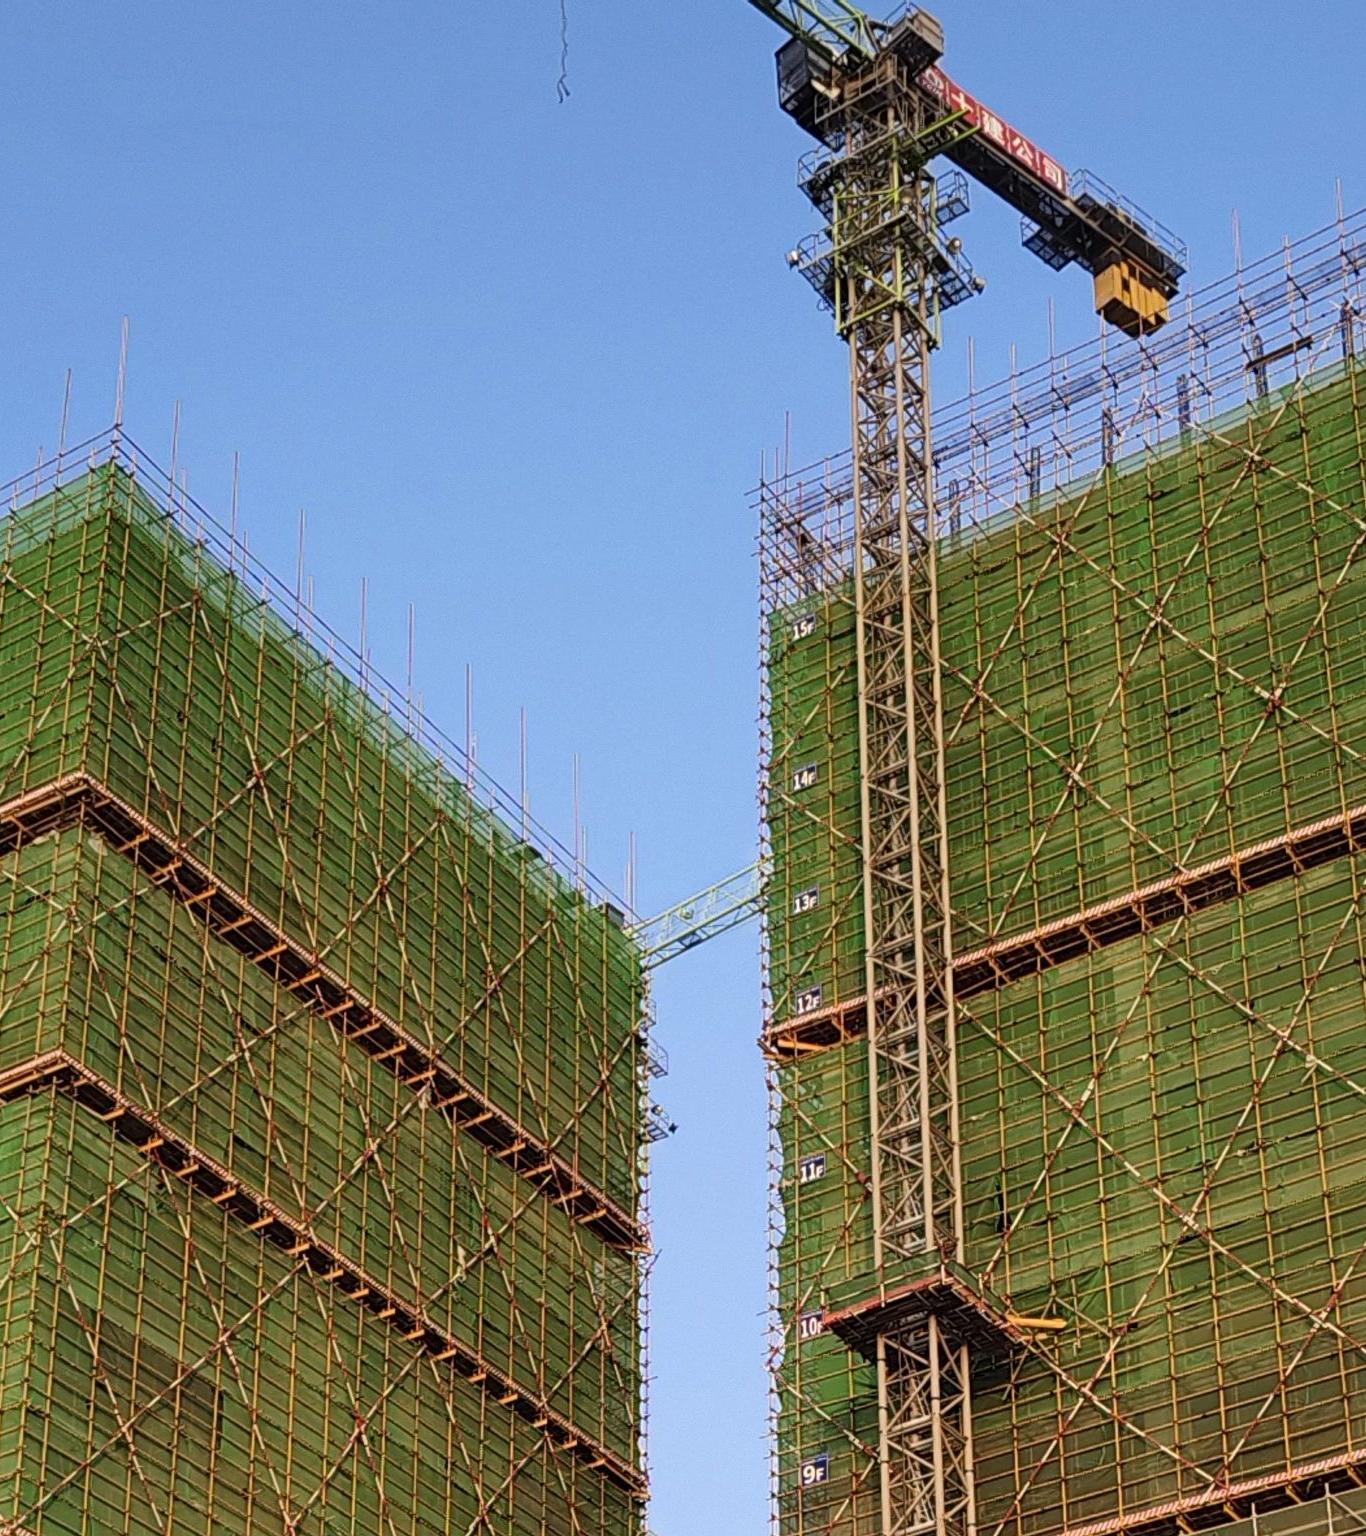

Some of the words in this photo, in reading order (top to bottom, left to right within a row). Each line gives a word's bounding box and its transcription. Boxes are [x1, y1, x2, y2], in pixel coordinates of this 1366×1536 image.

[793, 620, 814, 640] 15F
[794, 770, 816, 791] 14F
[794, 895, 817, 914] 13F
[797, 994, 820, 1014] 12F
[801, 1162, 823, 1183] 11F
[801, 1317, 824, 1338] 10F
[803, 1465, 824, 1484] 9F
